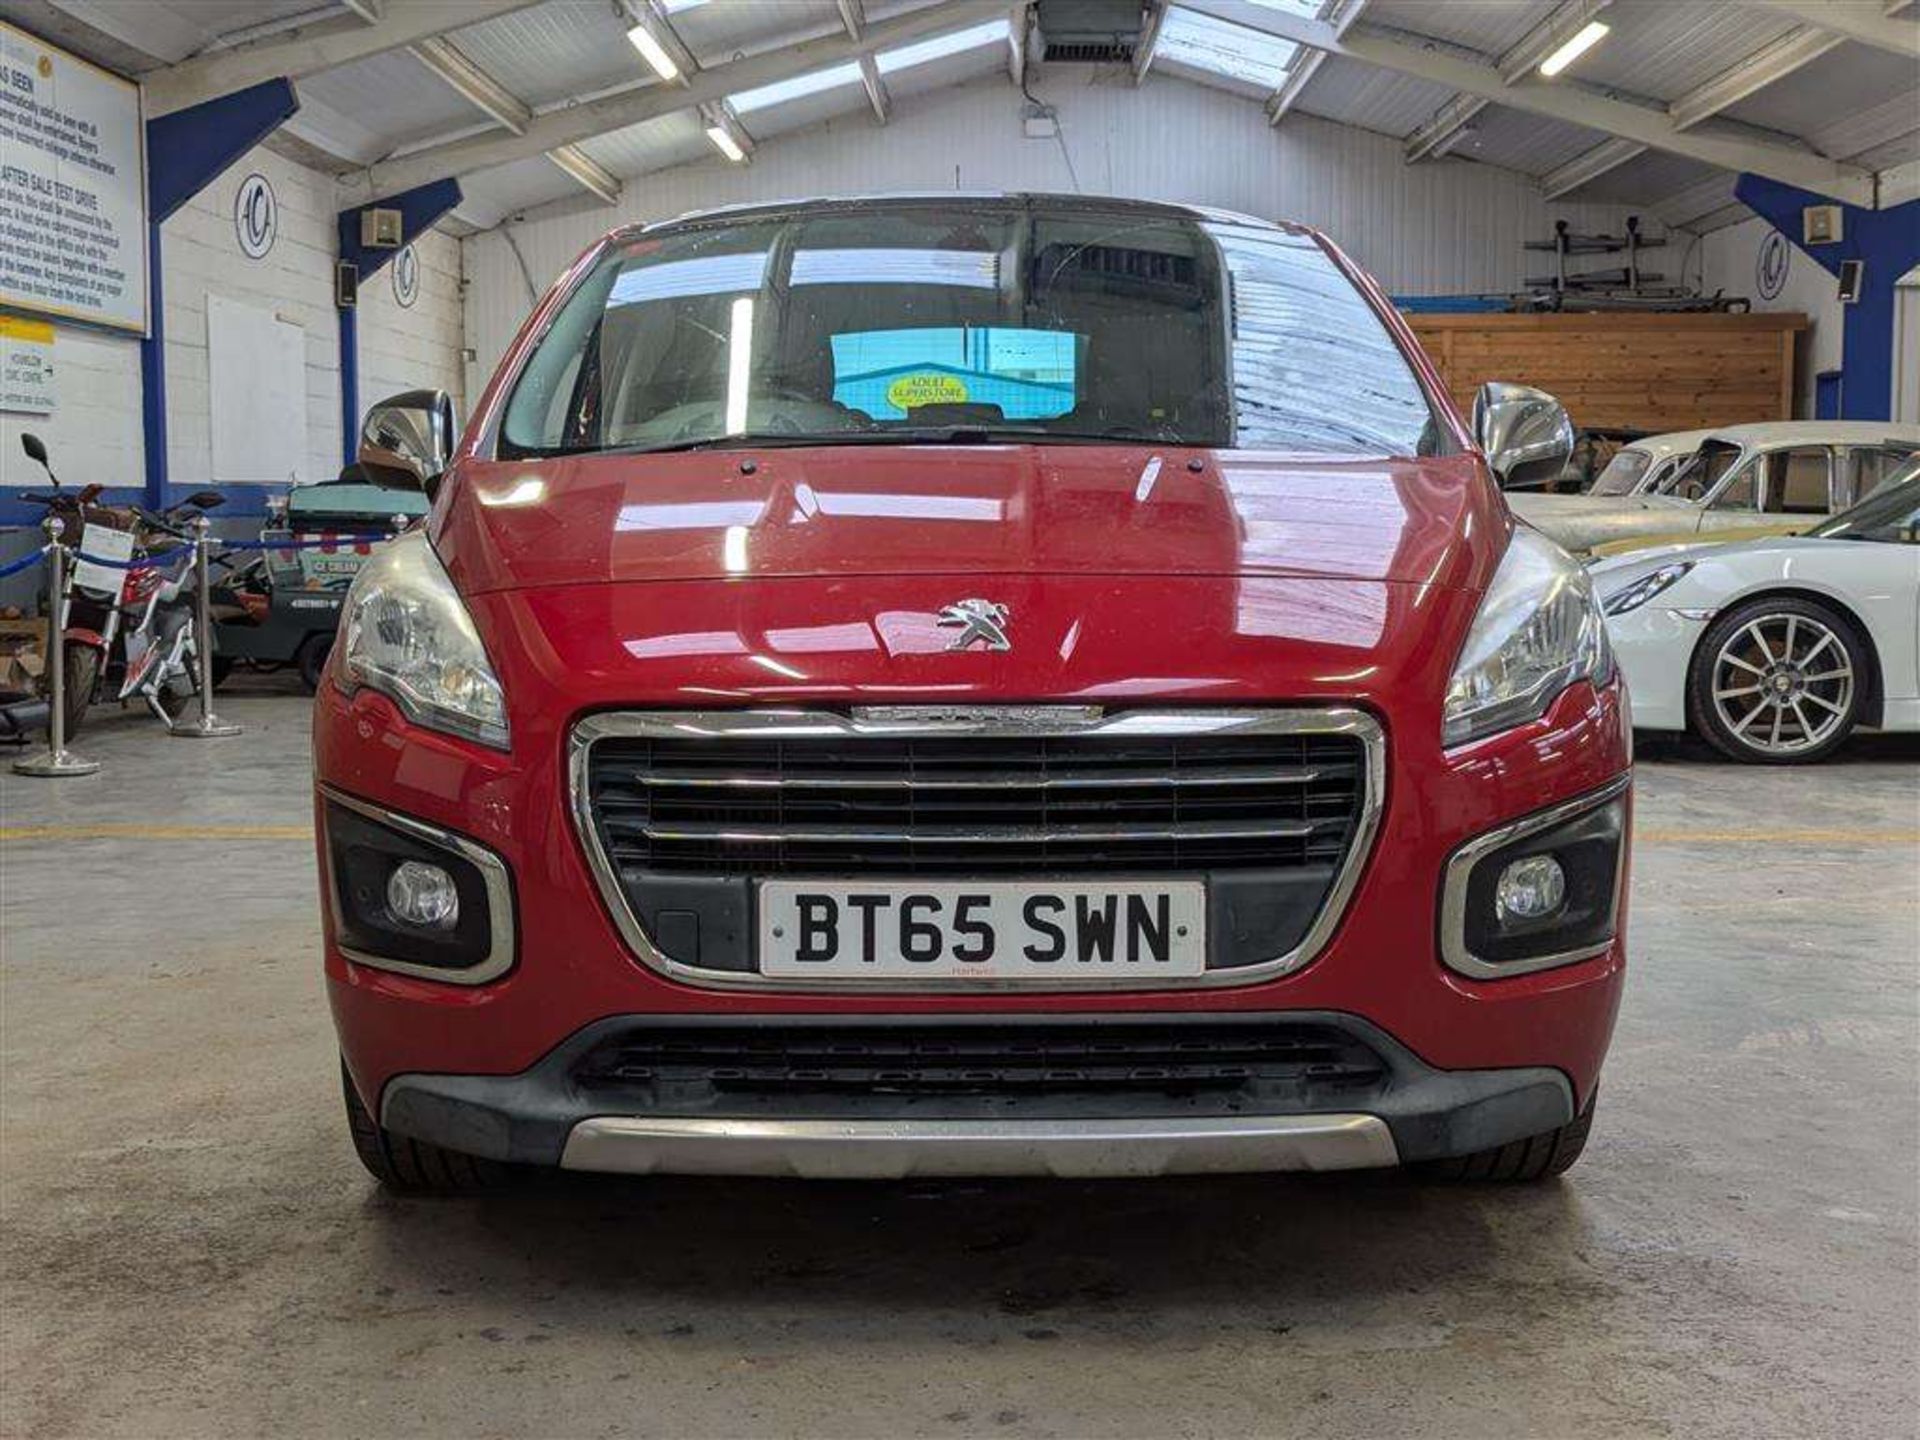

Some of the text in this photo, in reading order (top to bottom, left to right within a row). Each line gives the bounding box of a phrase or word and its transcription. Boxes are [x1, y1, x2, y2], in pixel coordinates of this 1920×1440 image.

[11, 69, 32, 93] SEEN
[1, 163, 97, 211] AFTER SALE TEST DRIVE
[893, 386, 962, 398] SUPERSTORE
[911, 376, 945, 387] ADULT
[795, 894, 1171, 963] BT65 SWN
